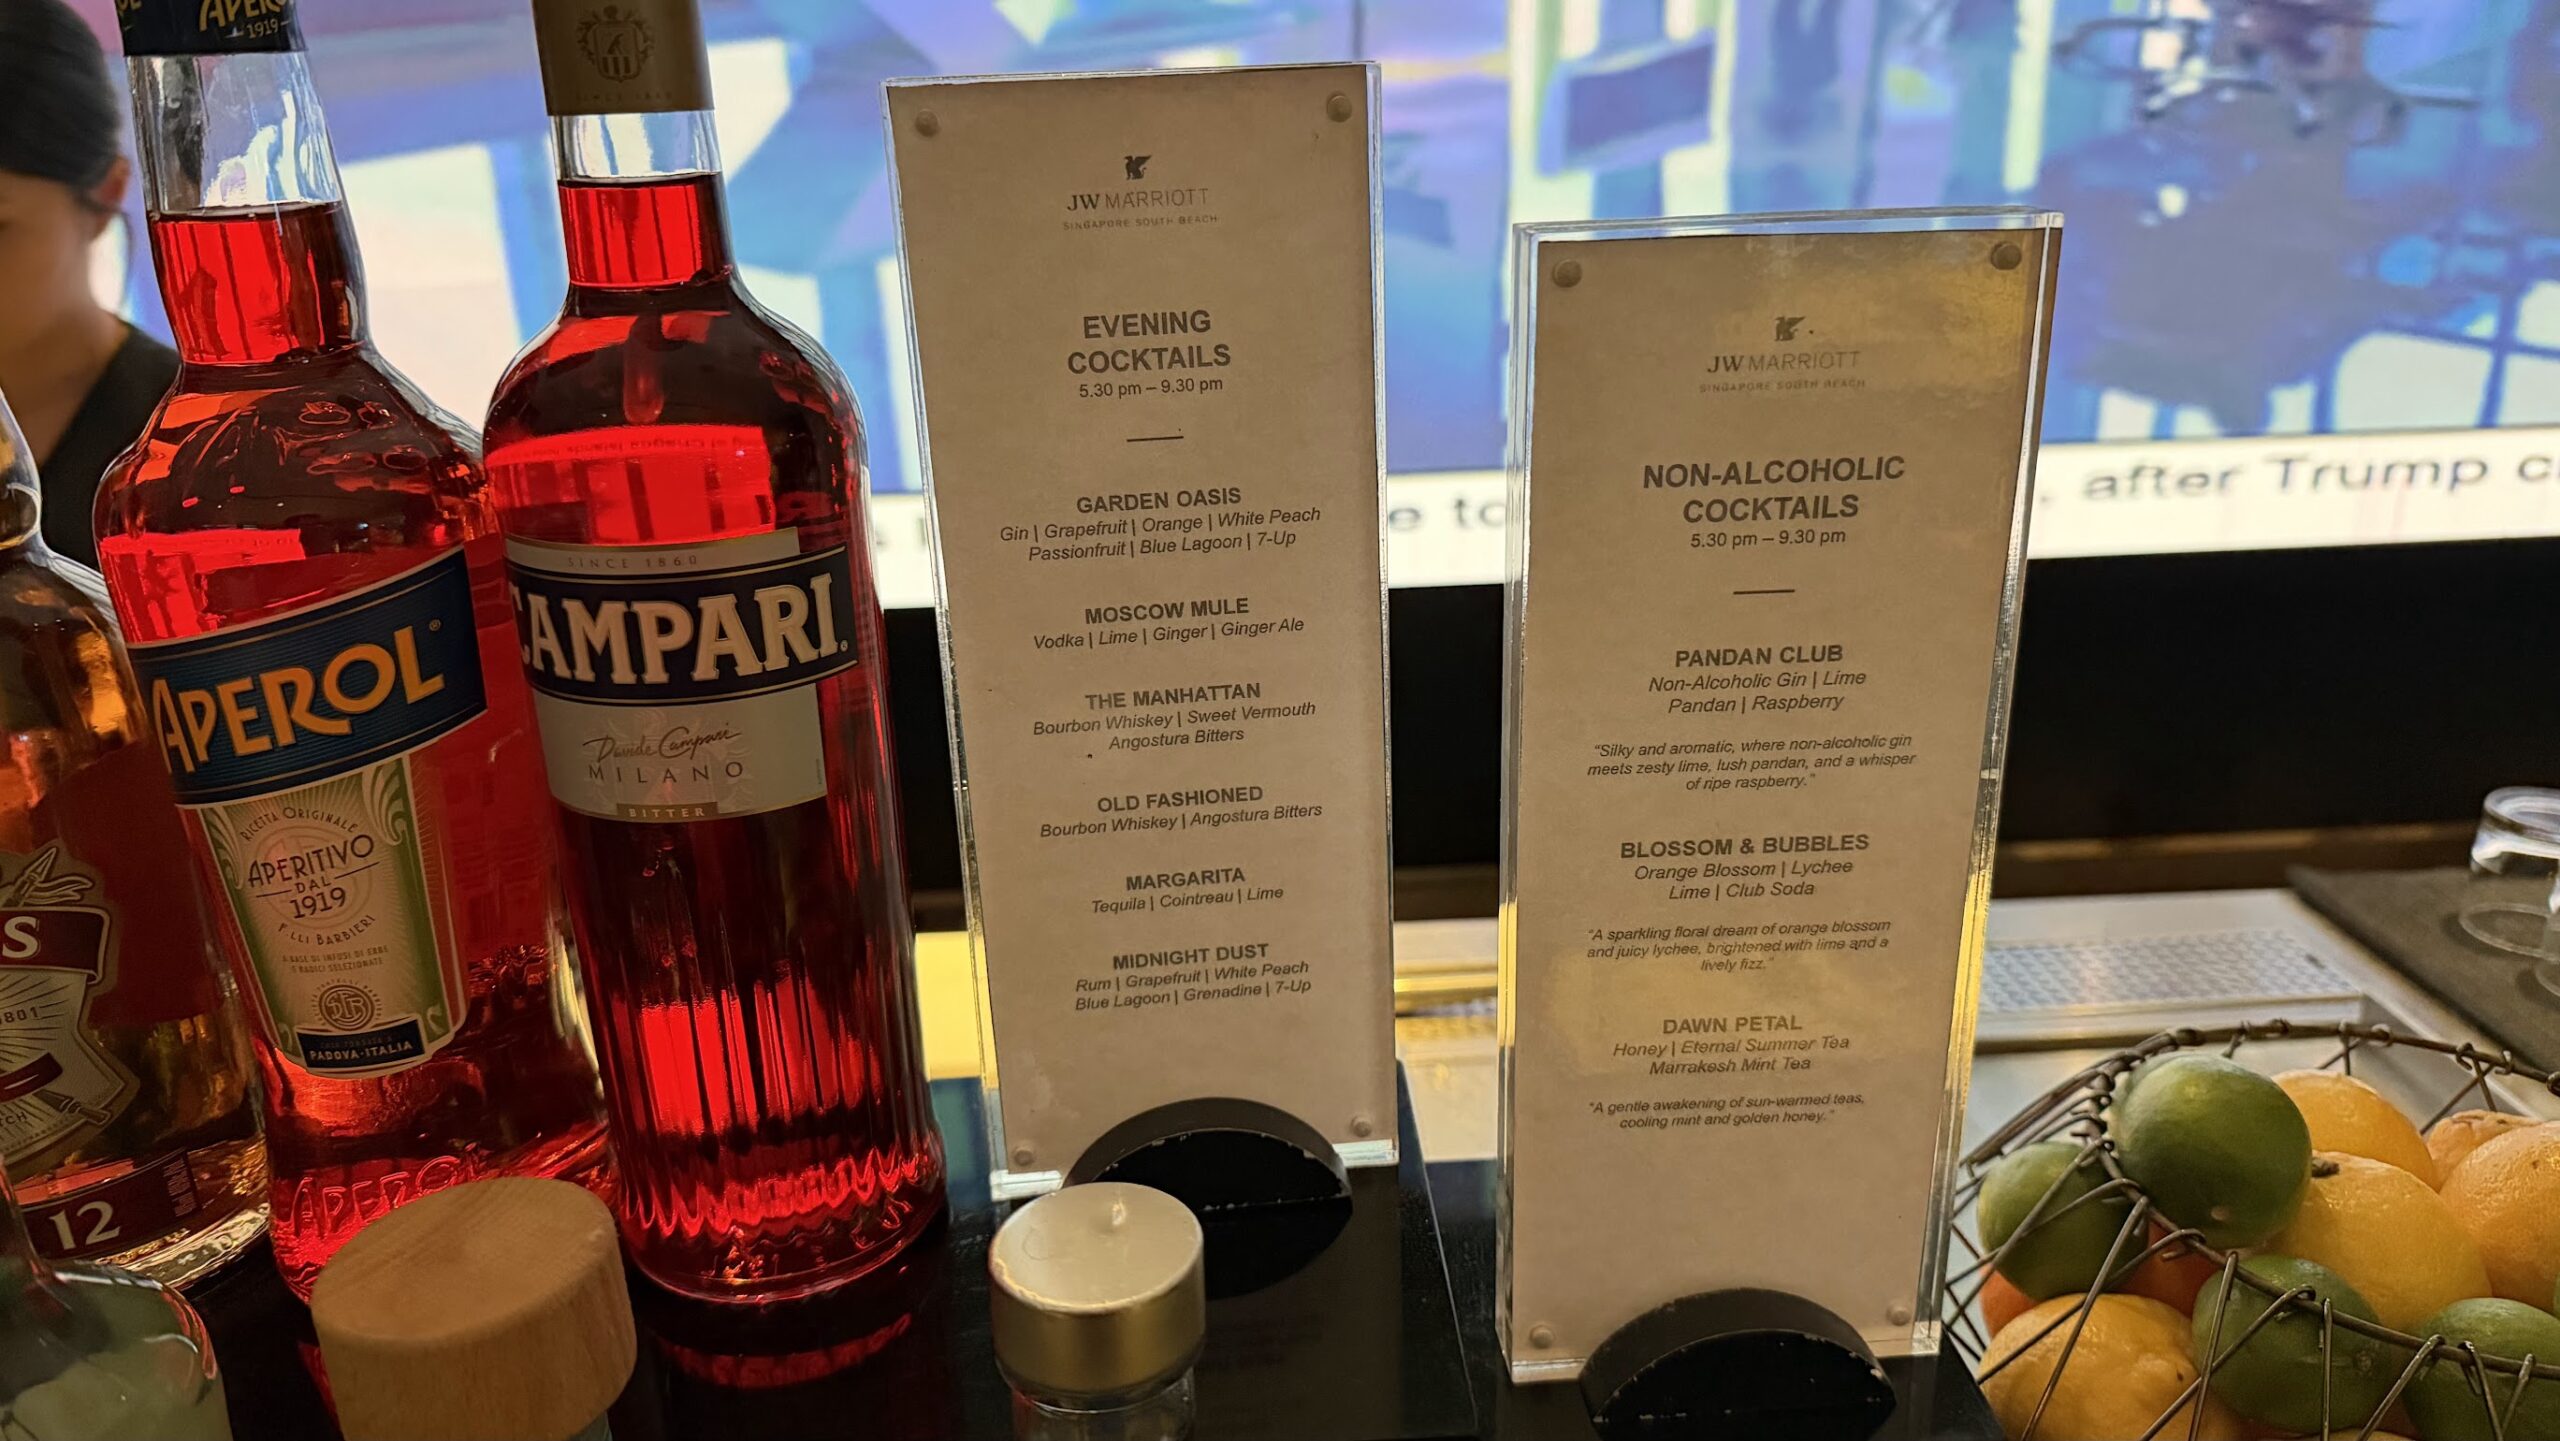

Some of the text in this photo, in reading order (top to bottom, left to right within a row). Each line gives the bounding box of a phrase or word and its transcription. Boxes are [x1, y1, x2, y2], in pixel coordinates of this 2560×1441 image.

[247, 18, 278, 38] 1919
[1067, 188, 1208, 212] JW MARRIOTT
[1063, 216, 1218, 230] SINGAPORE SOUTH BEACH
[1083, 310, 1211, 339] EVENING
[1068, 344, 1231, 374] COCKTAILS
[1707, 351, 1861, 373] JW MARRIOTT
[1079, 378, 1223, 399] 5.30 pm 9.30 pm
[1644, 456, 1905, 490] NON-ALCOHOLIC
[2084, 455, 2489, 500] after Trump
[1076, 486, 1241, 513] GARDEN OASIS
[1683, 494, 1859, 523] COCKTAILS
[1000, 506, 1320, 541] Gin Grapefruit Orange White Peach
[1028, 530, 1296, 561] Passionfruit Blue Lagoon 7-Up
[1691, 529, 1846, 549] 5.30 pm 9.30 pm
[568, 555, 698, 569] SINCE 1860
[1084, 597, 1249, 624] MOSCOW MULE
[1033, 617, 1304, 648] Vodka Lime Ginger Ginger Ale
[1675, 644, 1843, 667] PANDAN CLUB
[1648, 669, 1866, 692] Non-Alcoholic Gin Lime
[152, 625, 446, 774] APEROL
[1084, 682, 1260, 710] THE MANHATTAN
[1667, 693, 1845, 713] Pandan Raspberry
[1033, 701, 1316, 735] Bourbon Whiskey Sweet Vermouth
[658, 723, 741, 760] Campari
[1108, 728, 1244, 751] Angostura Bitters
[1637, 742, 1667, 756] and
[1668, 739, 1735, 754] aromatic,
[1740, 738, 1785, 752] where
[1788, 734, 1887, 750] non-alcoholic
[1888, 734, 1912, 749] gin
[588, 761, 744, 783] MILANO
[1586, 762, 1633, 776] meets
[1635, 761, 1675, 776] zesty
[1677, 759, 1711, 773] lime,
[1716, 757, 1747, 771] lush
[1749, 756, 1808, 772] pandan,
[1813, 754, 1843, 768] and
[1859, 753, 1916, 767] whisper
[1097, 786, 1263, 812] OLD FASHIONED
[240, 806, 358, 842] RICETTA ORIGINALE
[629, 808, 706, 819] BITTER
[1040, 804, 1322, 837] Bourbon Whiskey Angostura Bitters
[1620, 833, 1869, 858] BLOSSOM & BUBBLES
[248, 834, 374, 888] APERITIVO
[1634, 859, 1853, 882] Orange Blossom Lychee
[296, 876, 332, 894] DAL
[1126, 867, 1245, 891] MARGARITA
[1668, 880, 1814, 899] Lime Club Soda
[290, 886, 346, 919] 1919
[1091, 887, 1284, 914] Tequila Cointreau Lime
[317, 914, 376, 946] BARBIERI
[1606, 920, 1891, 943] sparkling floral dream of orange blossom
[1112, 942, 1269, 970] MIDNIGHT DUST
[1586, 935, 1877, 960] and juicy lychee, brightened with lime and
[1075, 960, 1309, 992] Rum Grapefruit White Peach
[1075, 979, 1311, 1011] Blue Lagoon Grenadine 7-Up
[0, 1006, 38, 1024] 801
[1662, 1014, 1802, 1034] DAWN PETAL
[1612, 1034, 1849, 1058] Honey Eternal Summer Tea
[1648, 1056, 1811, 1075] Marrakesh Mint Tea
[1607, 1093, 1864, 1116] gentle awakening of sun-warmed teas,
[1619, 1116, 1668, 1129] cooling
[1672, 1114, 1702, 1126] mint
[1703, 1112, 1731, 1125] and
[1732, 1111, 1779, 1126] golden
[50, 1201, 122, 1250] 12
